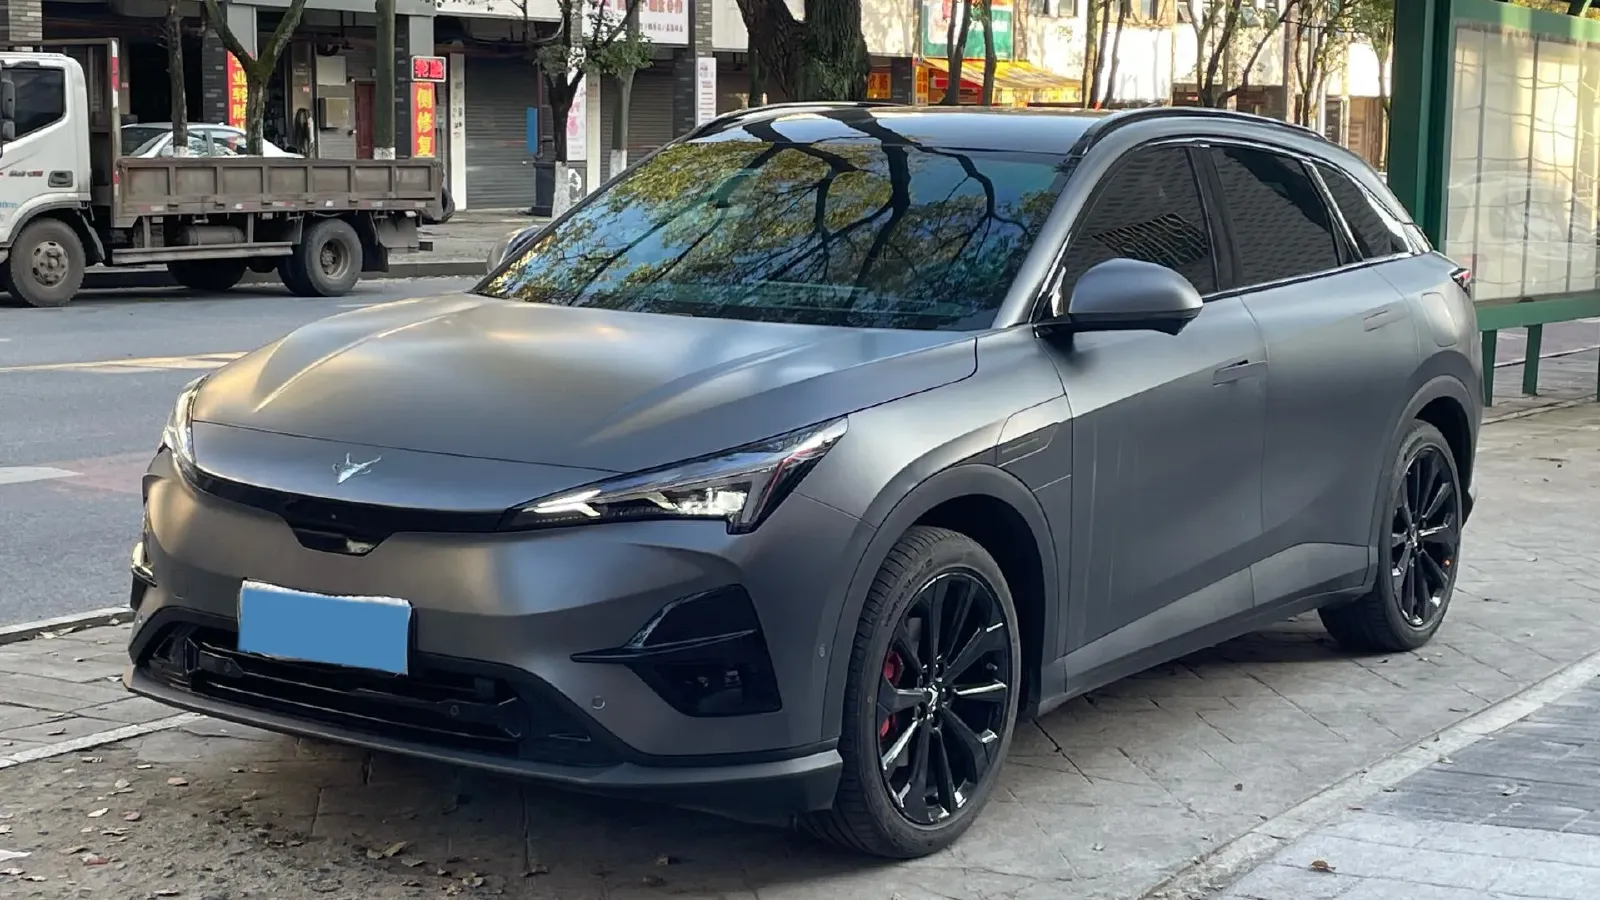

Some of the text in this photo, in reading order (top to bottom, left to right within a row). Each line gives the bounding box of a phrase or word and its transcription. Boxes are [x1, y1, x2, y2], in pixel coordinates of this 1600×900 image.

[231, 54, 248, 128] 业轮胎
[414, 59, 444, 79] 轮胎
[416, 82, 434, 157] 侧修复
